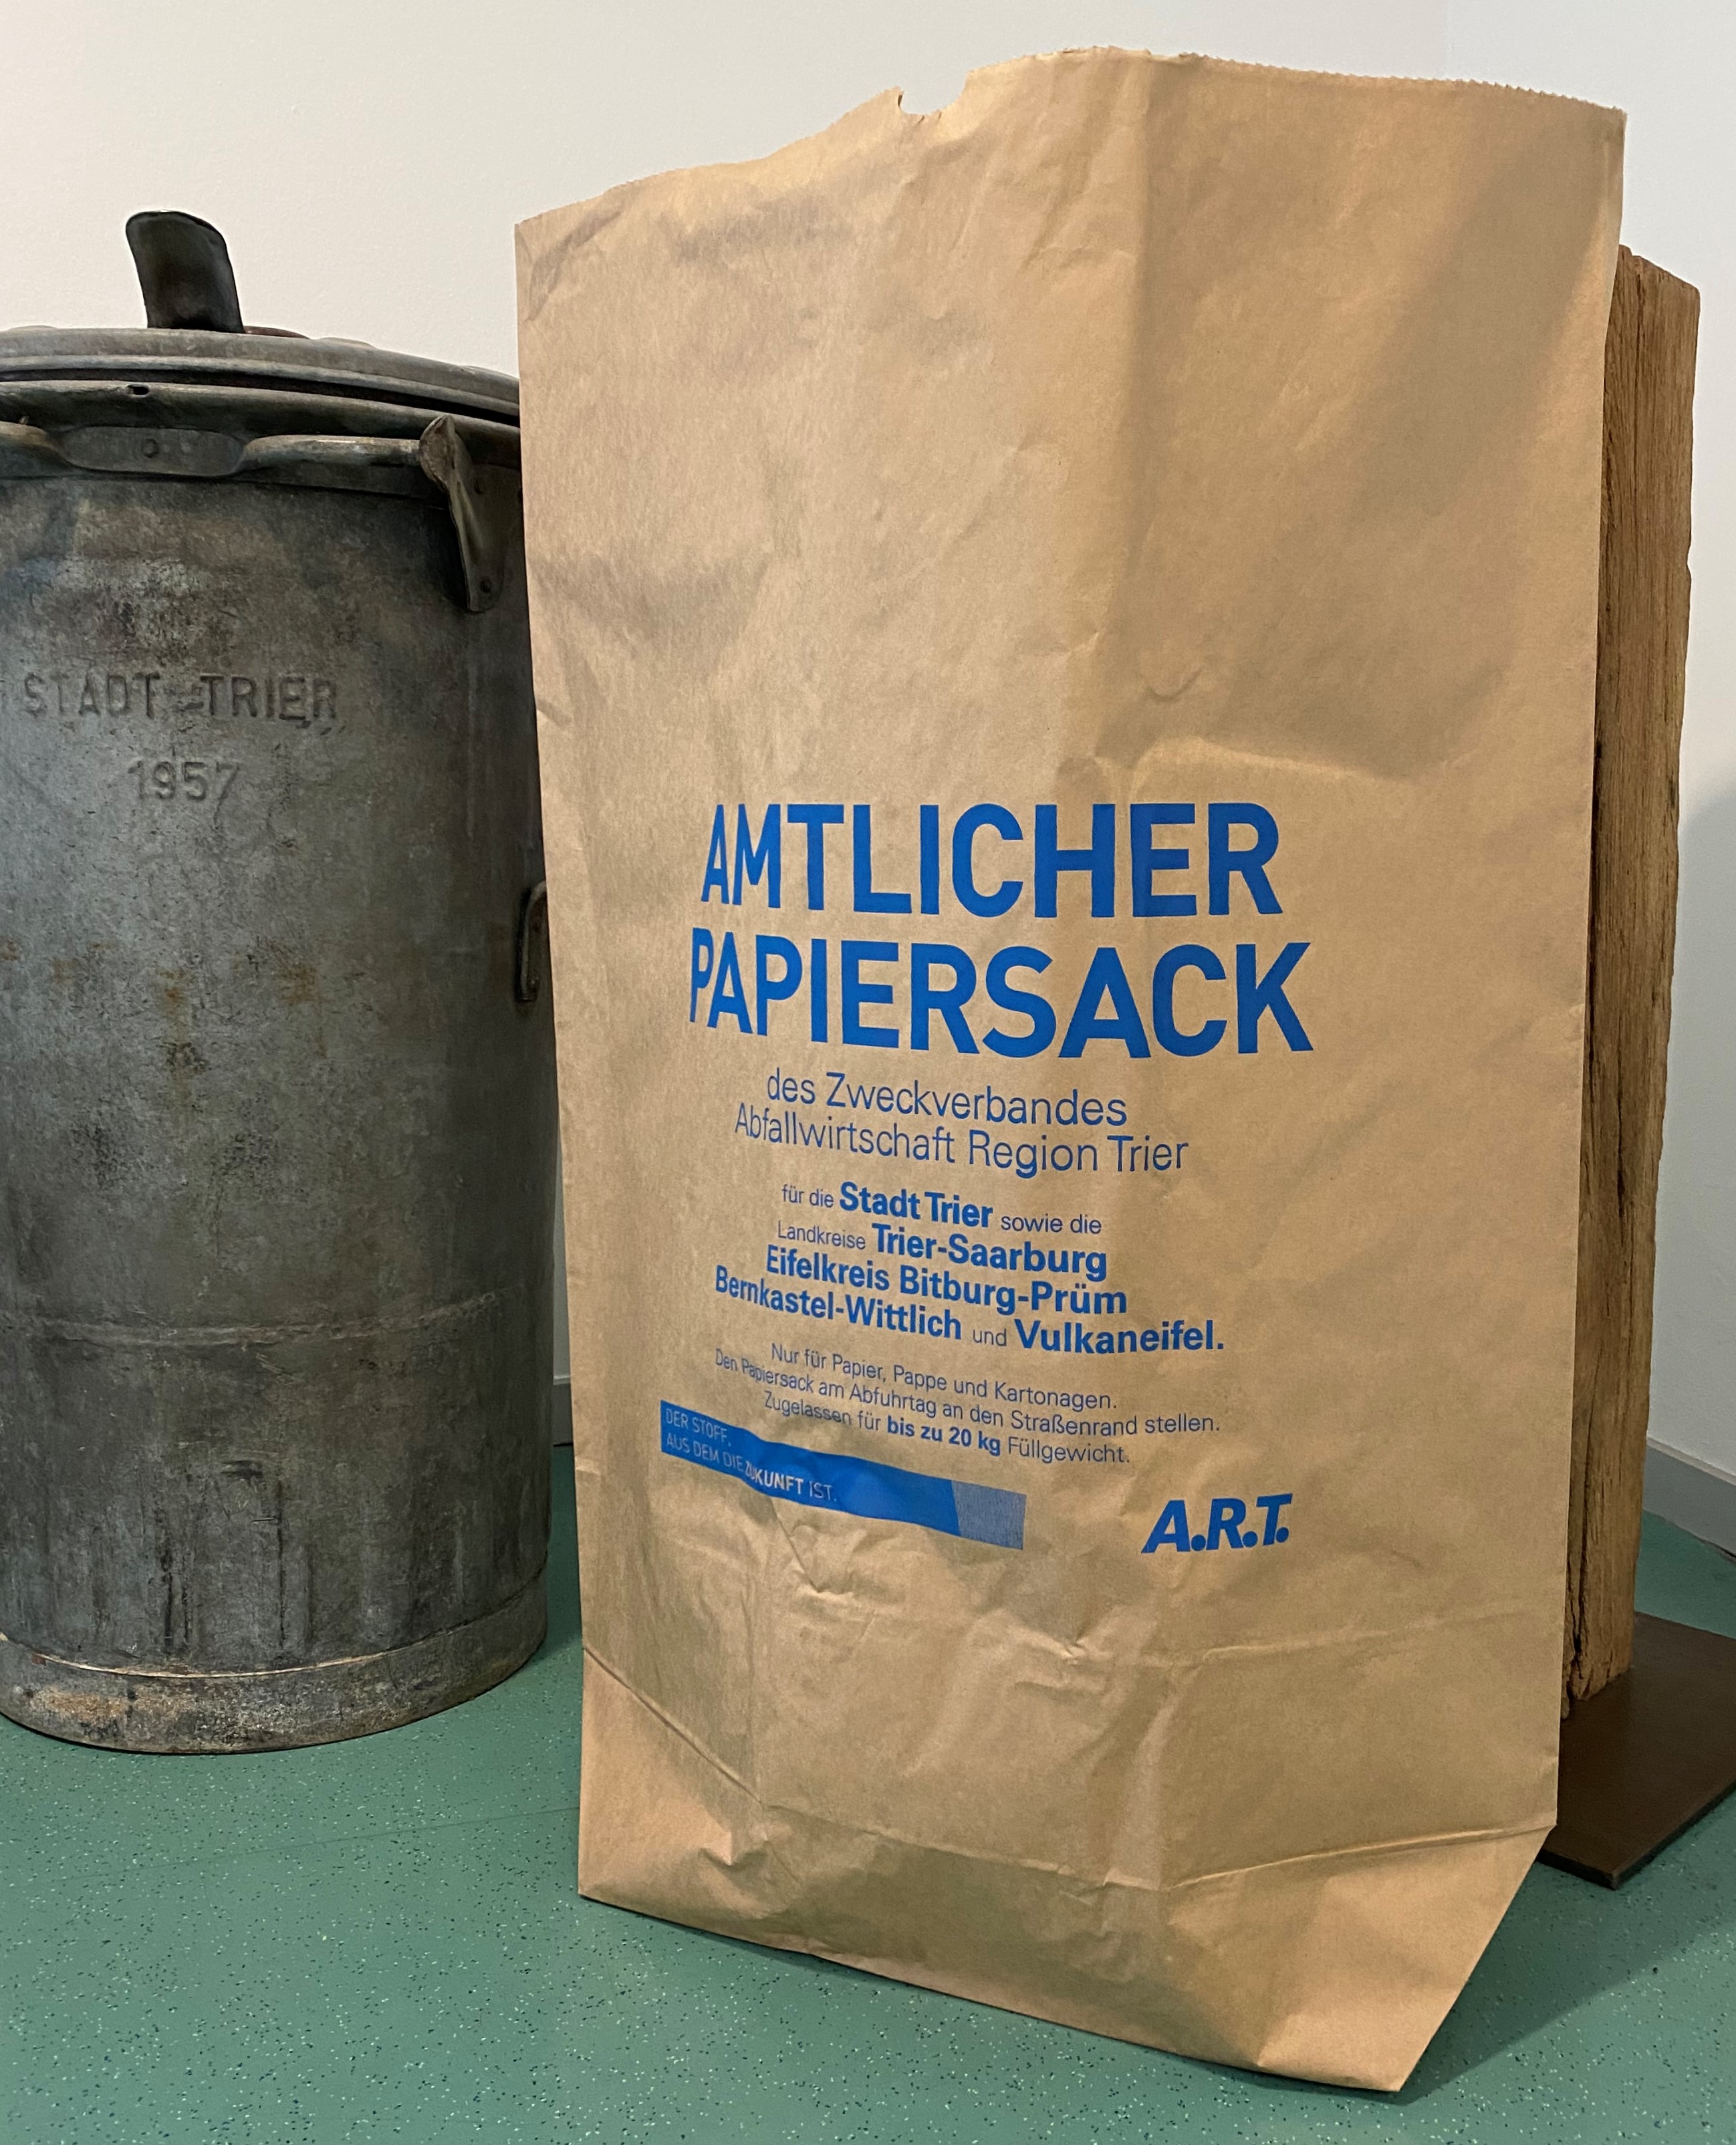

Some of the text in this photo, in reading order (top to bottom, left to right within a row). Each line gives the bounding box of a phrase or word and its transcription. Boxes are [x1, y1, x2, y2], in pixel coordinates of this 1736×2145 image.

[130, 759, 240, 802] 1957
[700, 802, 1283, 918] AMTLICHER
[689, 926, 1314, 1059] PAPIERSACK
[767, 1068, 1128, 1128] des Zweckverbandes
[735, 1103, 1189, 1180] Abfallwirtschaft Region Trier
[782, 1180, 1102, 1235] für die Stadt Trier sowie die
[766, 1244, 1128, 1316] Eifelkreis Bitburg-Prüm
[777, 1221, 1107, 1282] Landkreise Trier-Saarburg
[715, 1264, 1225, 1355] Bernkastel-Wittlich und Vulkaneifel.
[715, 1347, 1221, 1436] Den Papiersack am Abfuhrtag an den Straßenrand stellen.
[771, 1342, 1118, 1412] Nur für Papier, Pappe und Kartonagen.
[665, 1408, 689, 1430] DER
[763, 1390, 1131, 1465] Zugelassen für bis zu 20 kg Füllgewicht.
[666, 1432, 838, 1502] AUS DEM DIE ZUKUNFT IST.
[1140, 1493, 1293, 1554] A.R.T.
